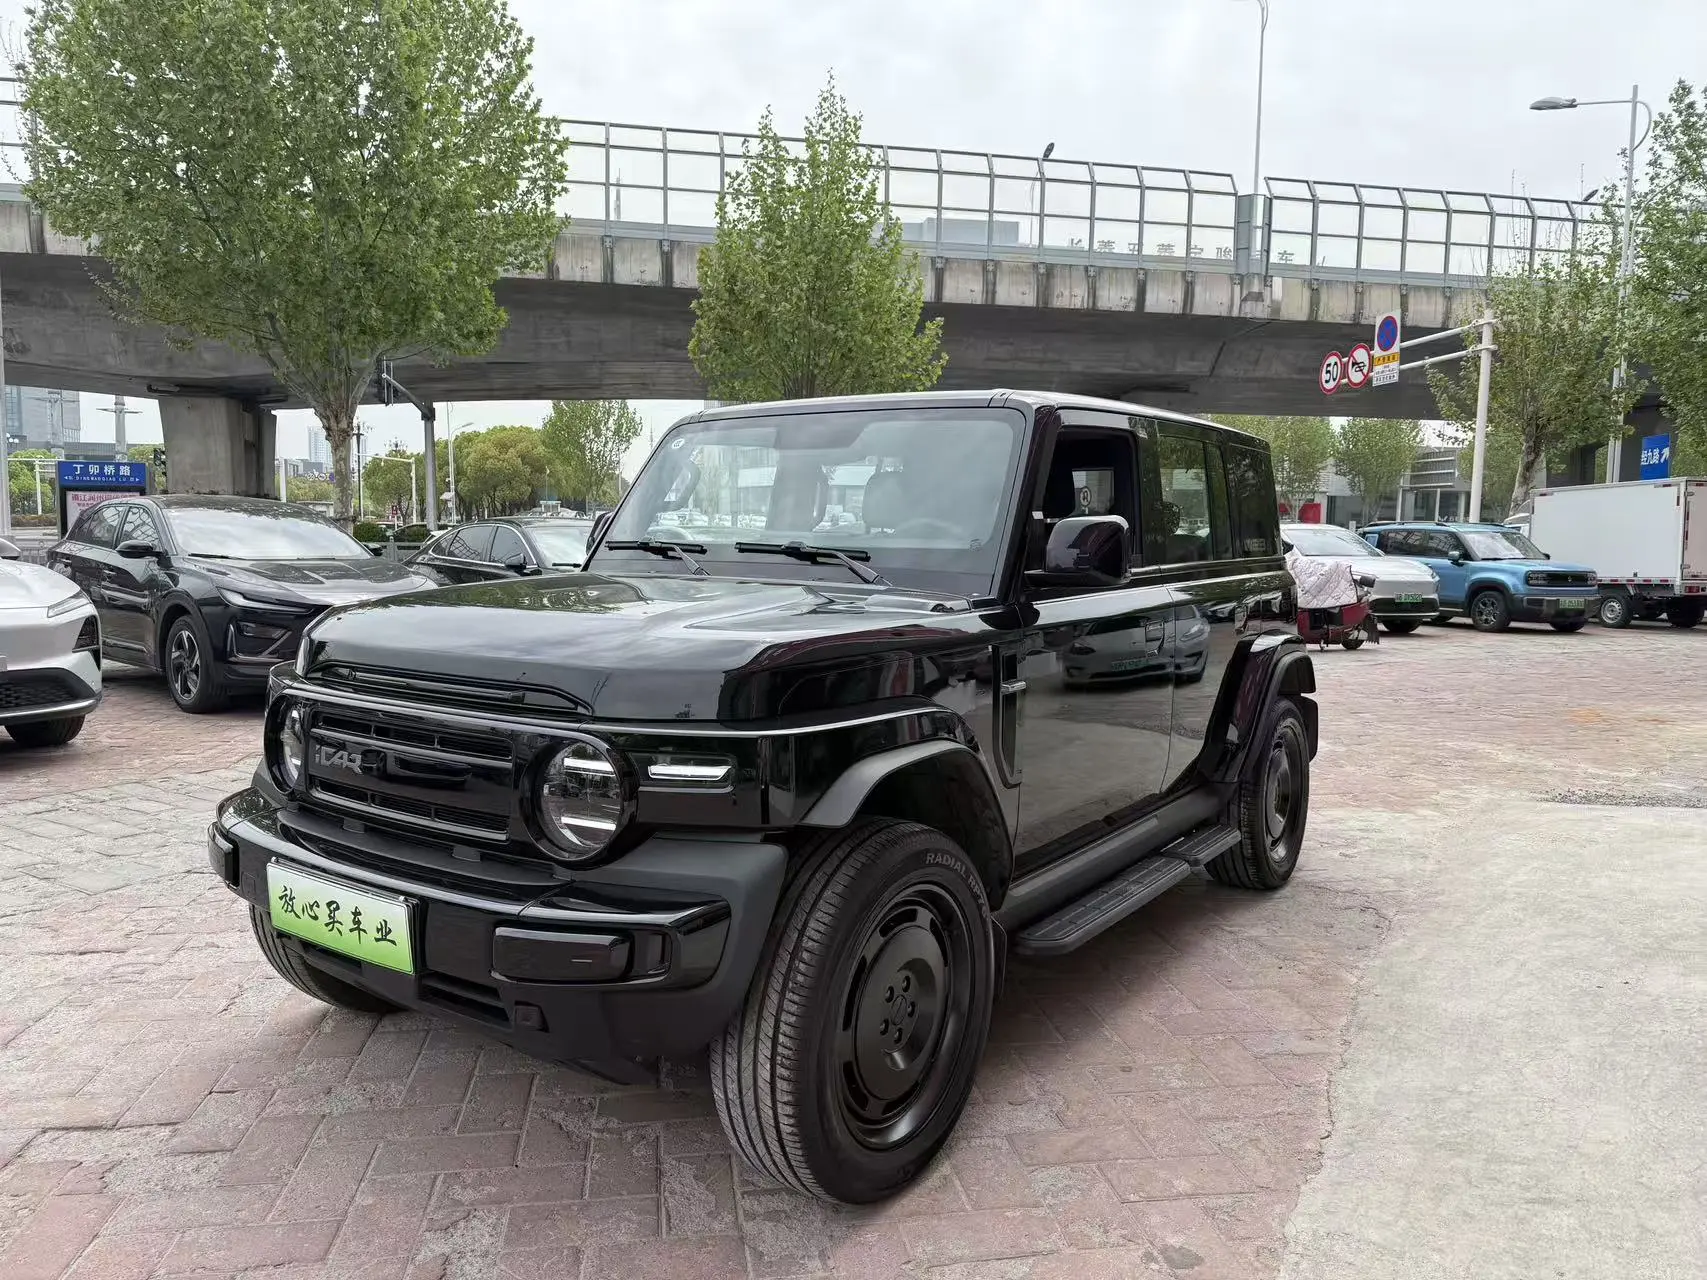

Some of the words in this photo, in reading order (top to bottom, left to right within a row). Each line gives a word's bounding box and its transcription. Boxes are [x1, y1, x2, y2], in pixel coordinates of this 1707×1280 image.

[1325, 362, 1338, 383] 50
[1640, 447, 1660, 465] 经九路
[72, 464, 131, 477] 丁卯桥路
[925, 852, 969, 878] RADIAL
[278, 885, 397, 947] 放心买车业
